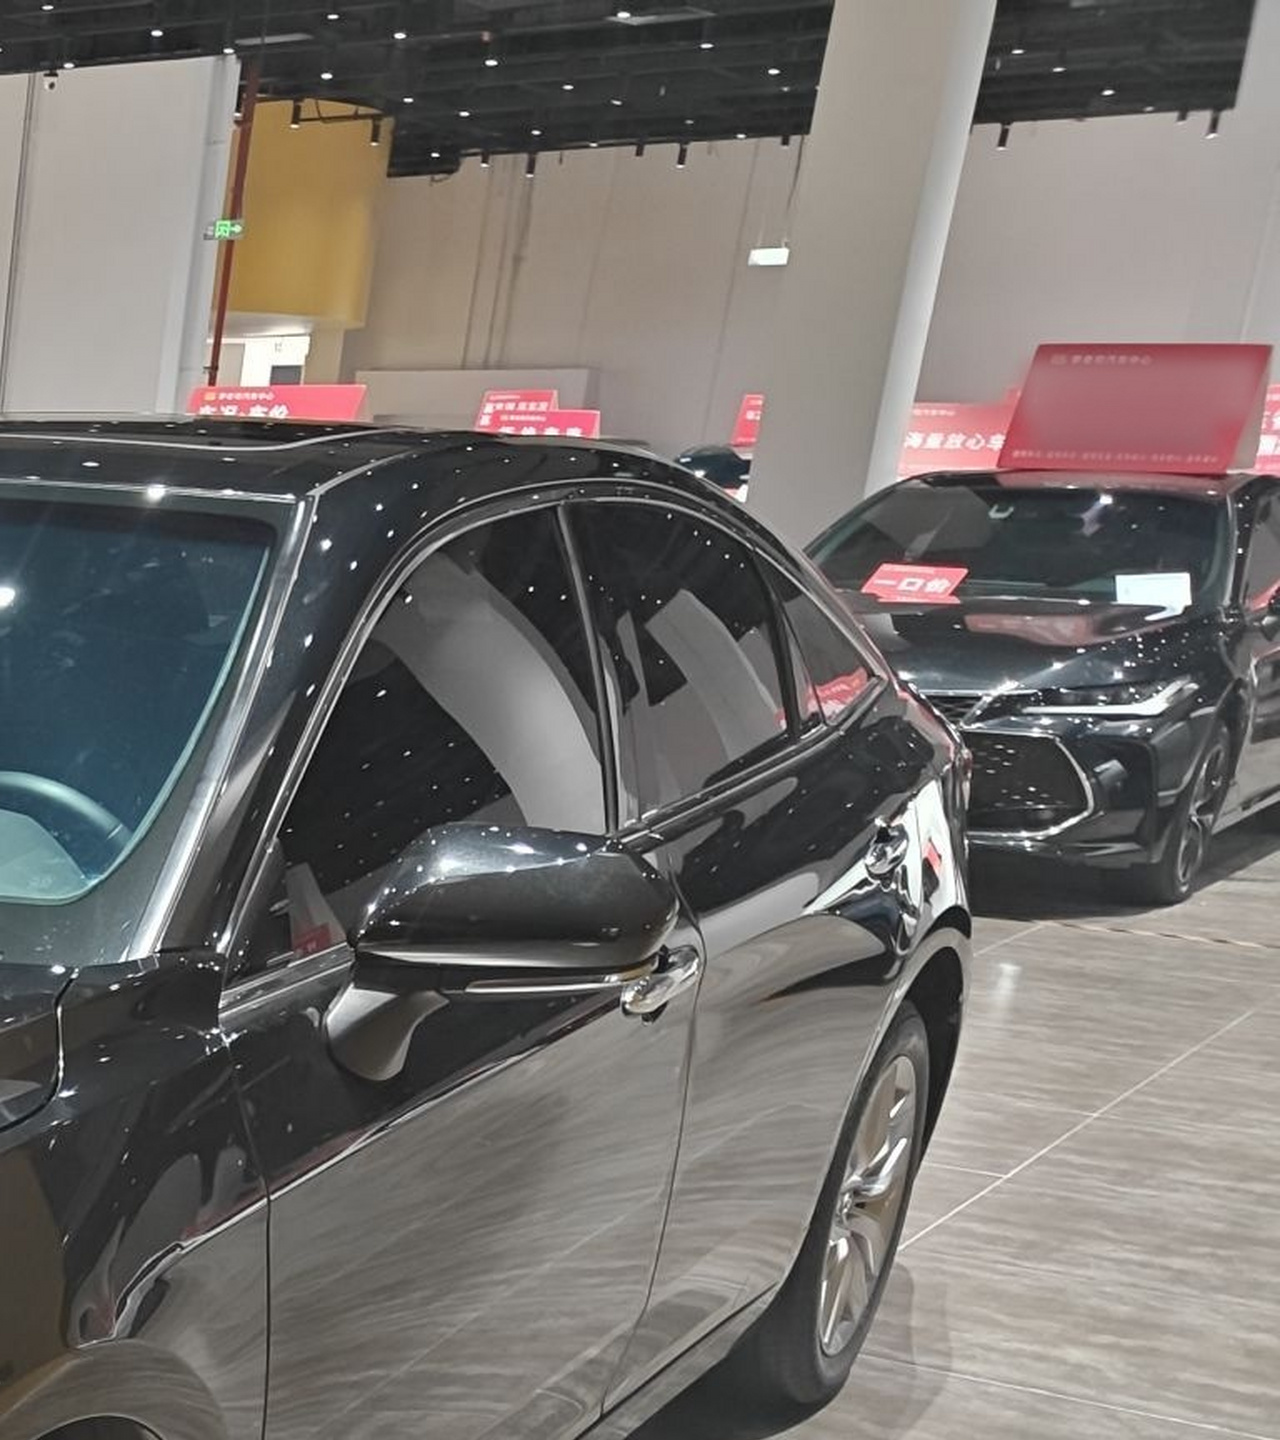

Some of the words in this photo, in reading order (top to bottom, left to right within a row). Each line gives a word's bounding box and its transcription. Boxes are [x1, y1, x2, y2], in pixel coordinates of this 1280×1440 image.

[903, 431, 1006, 451] 海量放心车
[873, 577, 952, 594] 一口价
